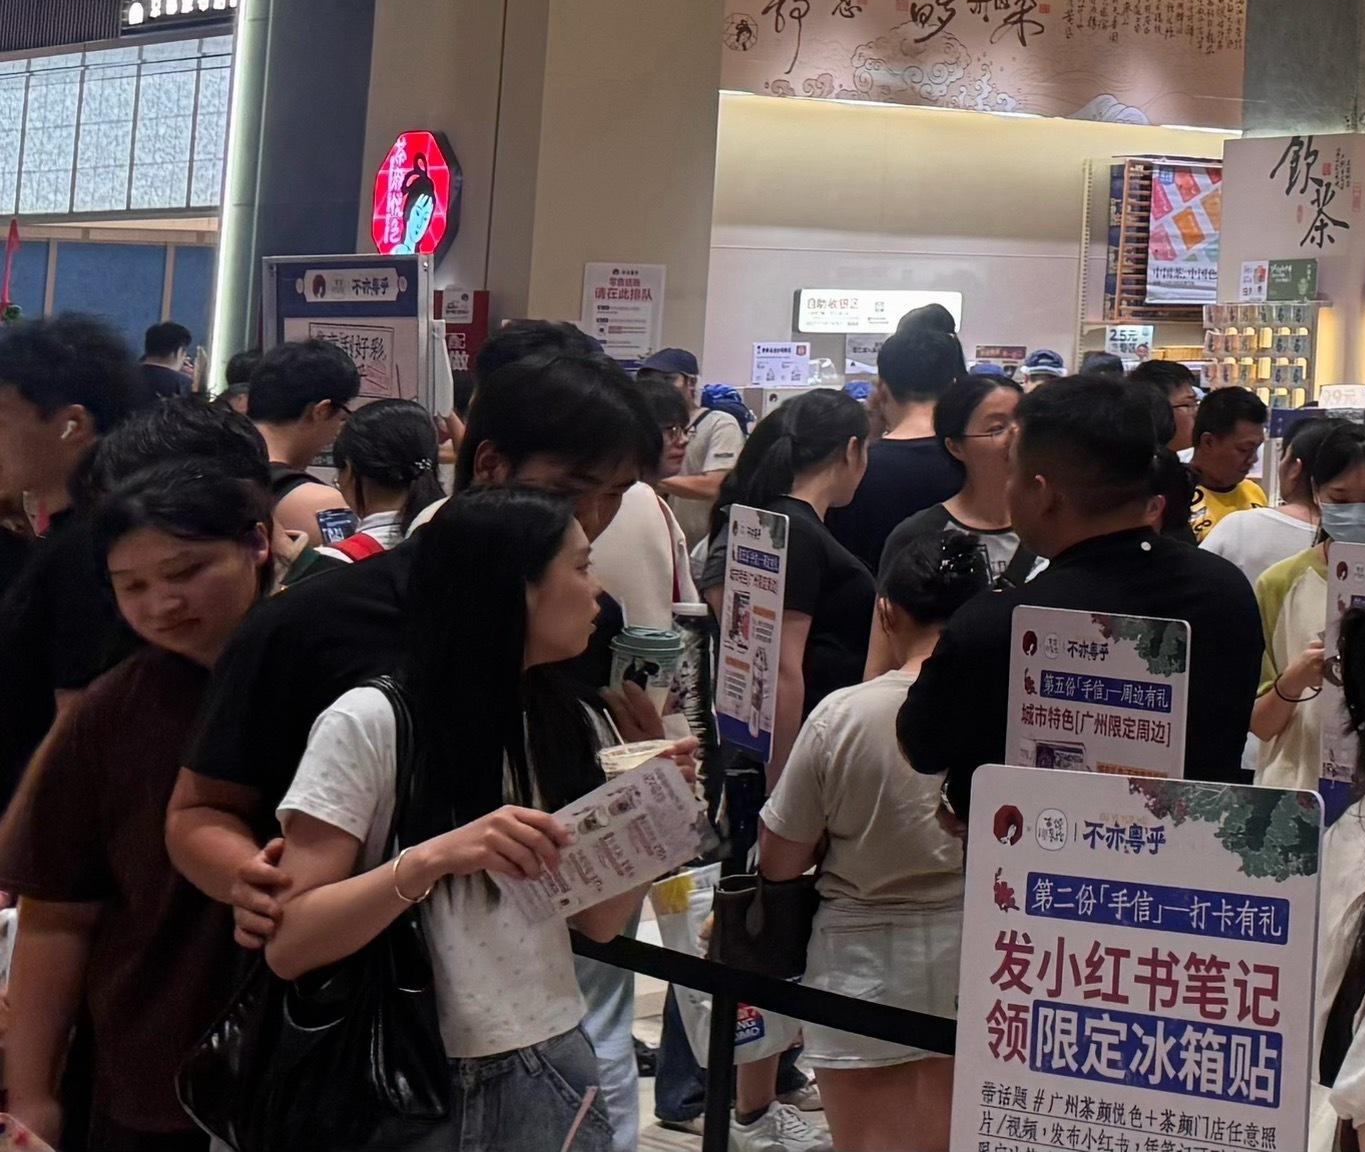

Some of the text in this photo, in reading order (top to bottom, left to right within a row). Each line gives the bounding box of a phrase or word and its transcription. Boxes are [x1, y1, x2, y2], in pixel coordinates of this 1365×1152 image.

[1067, 640, 1110, 661] 不亦粤乎
[1083, 820, 1167, 855] 不亦粤乎
[989, 930, 1280, 1027] 发小红书笔记
